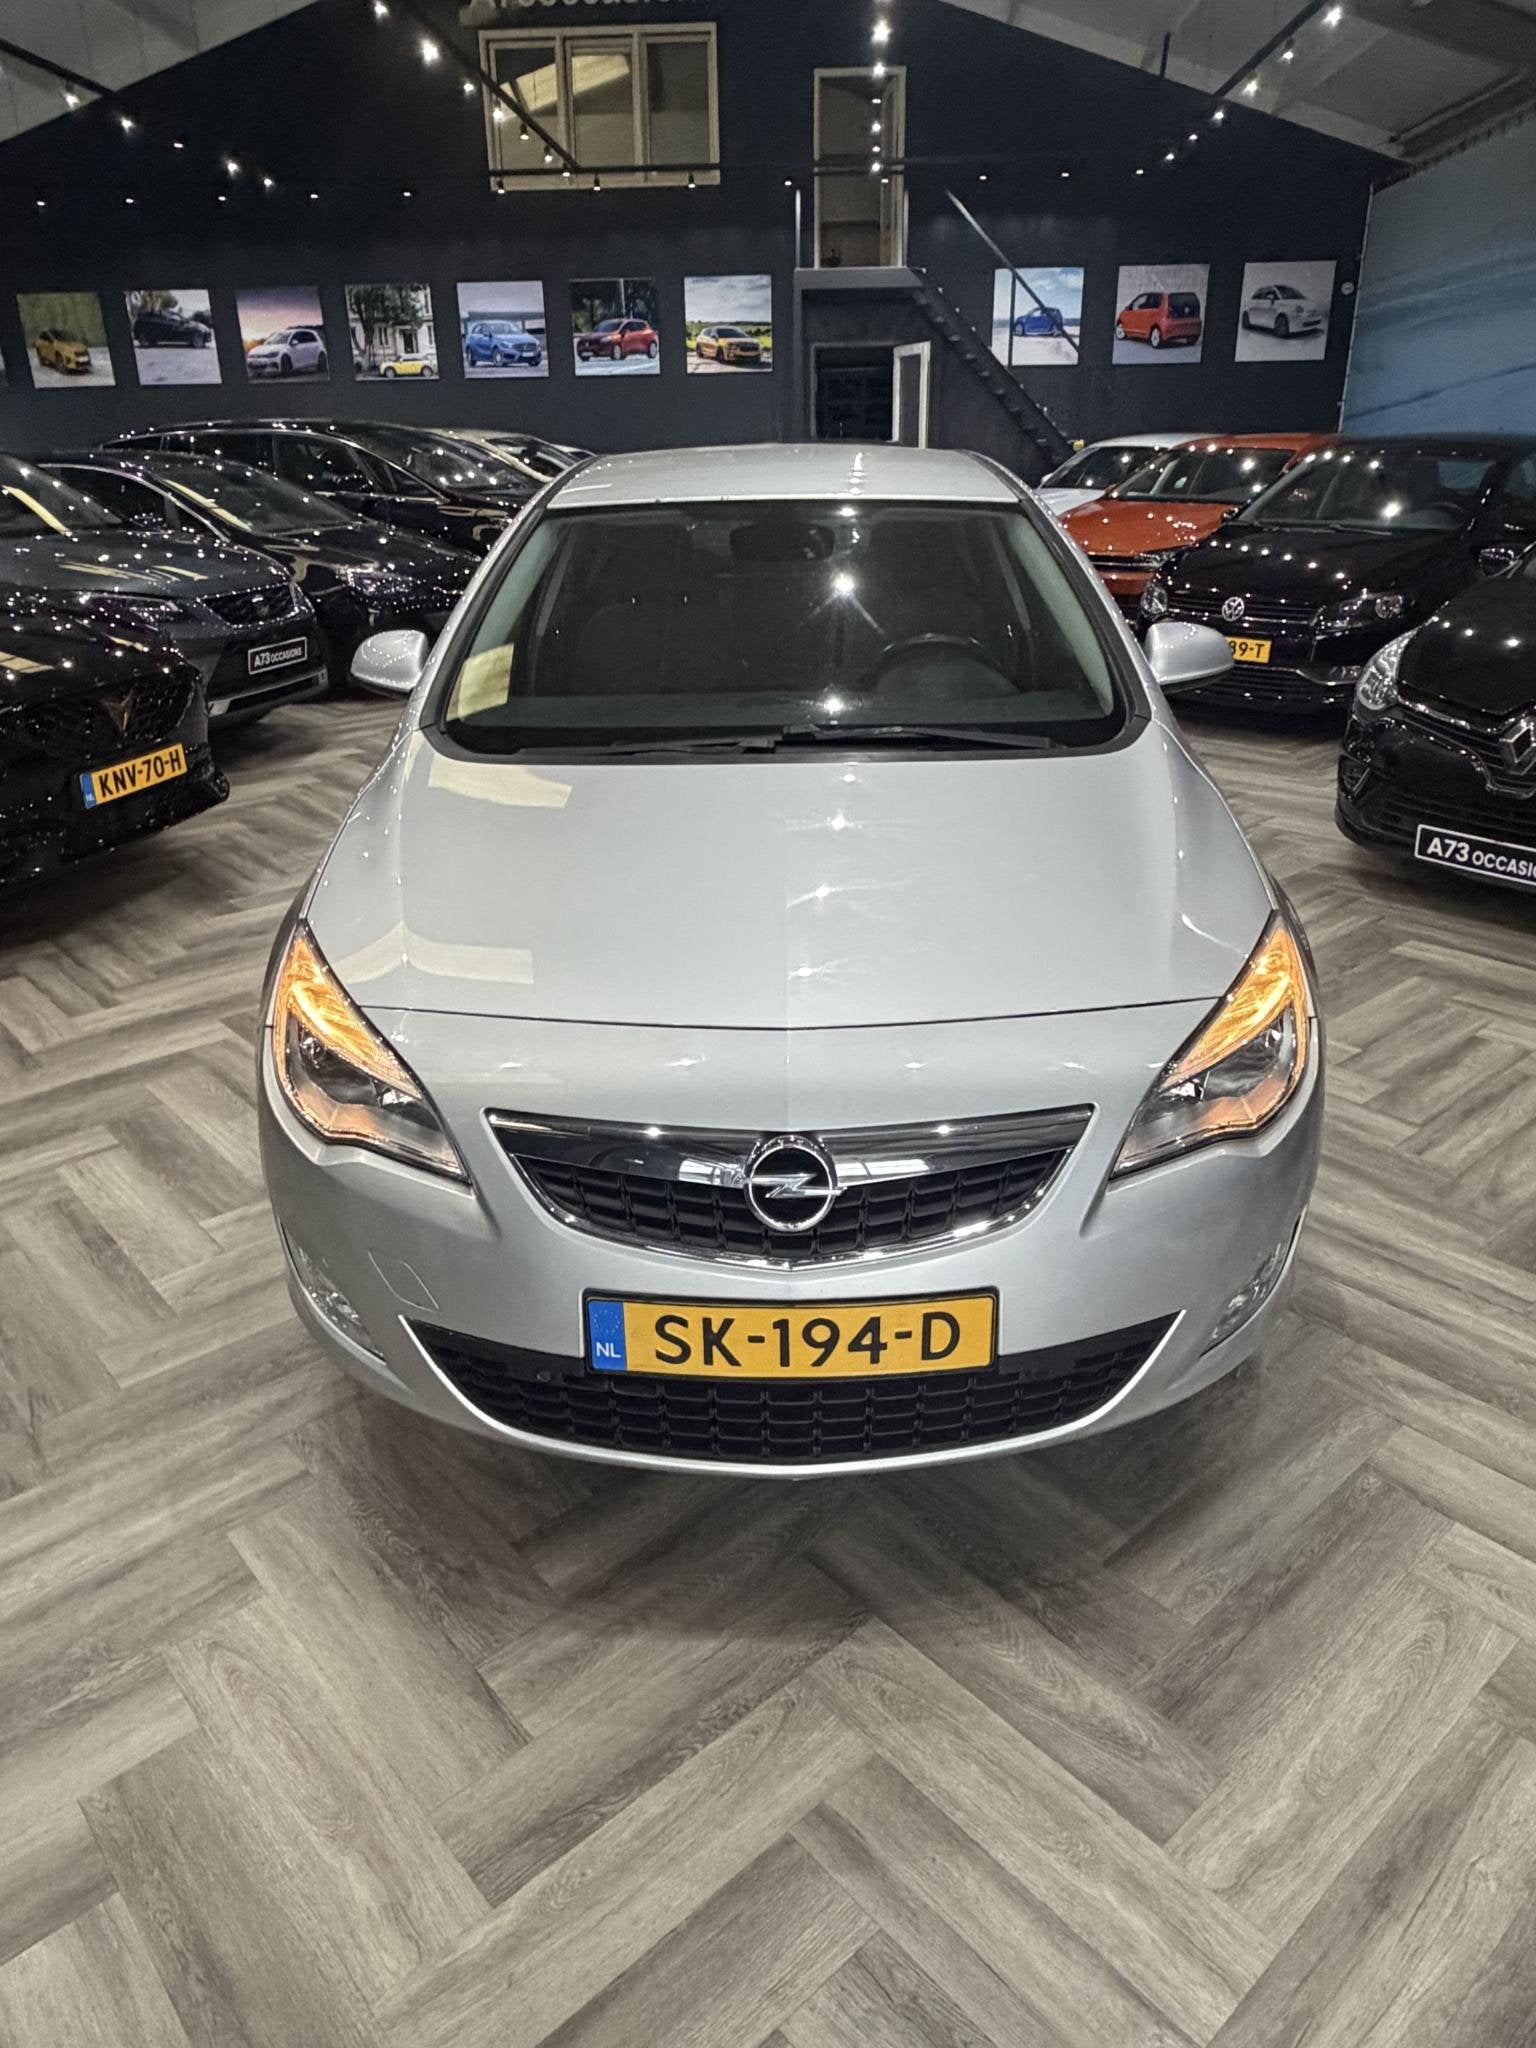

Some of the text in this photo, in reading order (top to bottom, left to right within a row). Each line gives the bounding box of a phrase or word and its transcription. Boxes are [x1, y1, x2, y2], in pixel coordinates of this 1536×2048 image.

[254, 646, 303, 668] A73 OCCASIONS
[99, 748, 182, 798] KNV-70-H
[1426, 837, 1536, 878] A73 OCCASI
[596, 1341, 622, 1358] NL
[655, 1311, 961, 1367] SK-194-D
